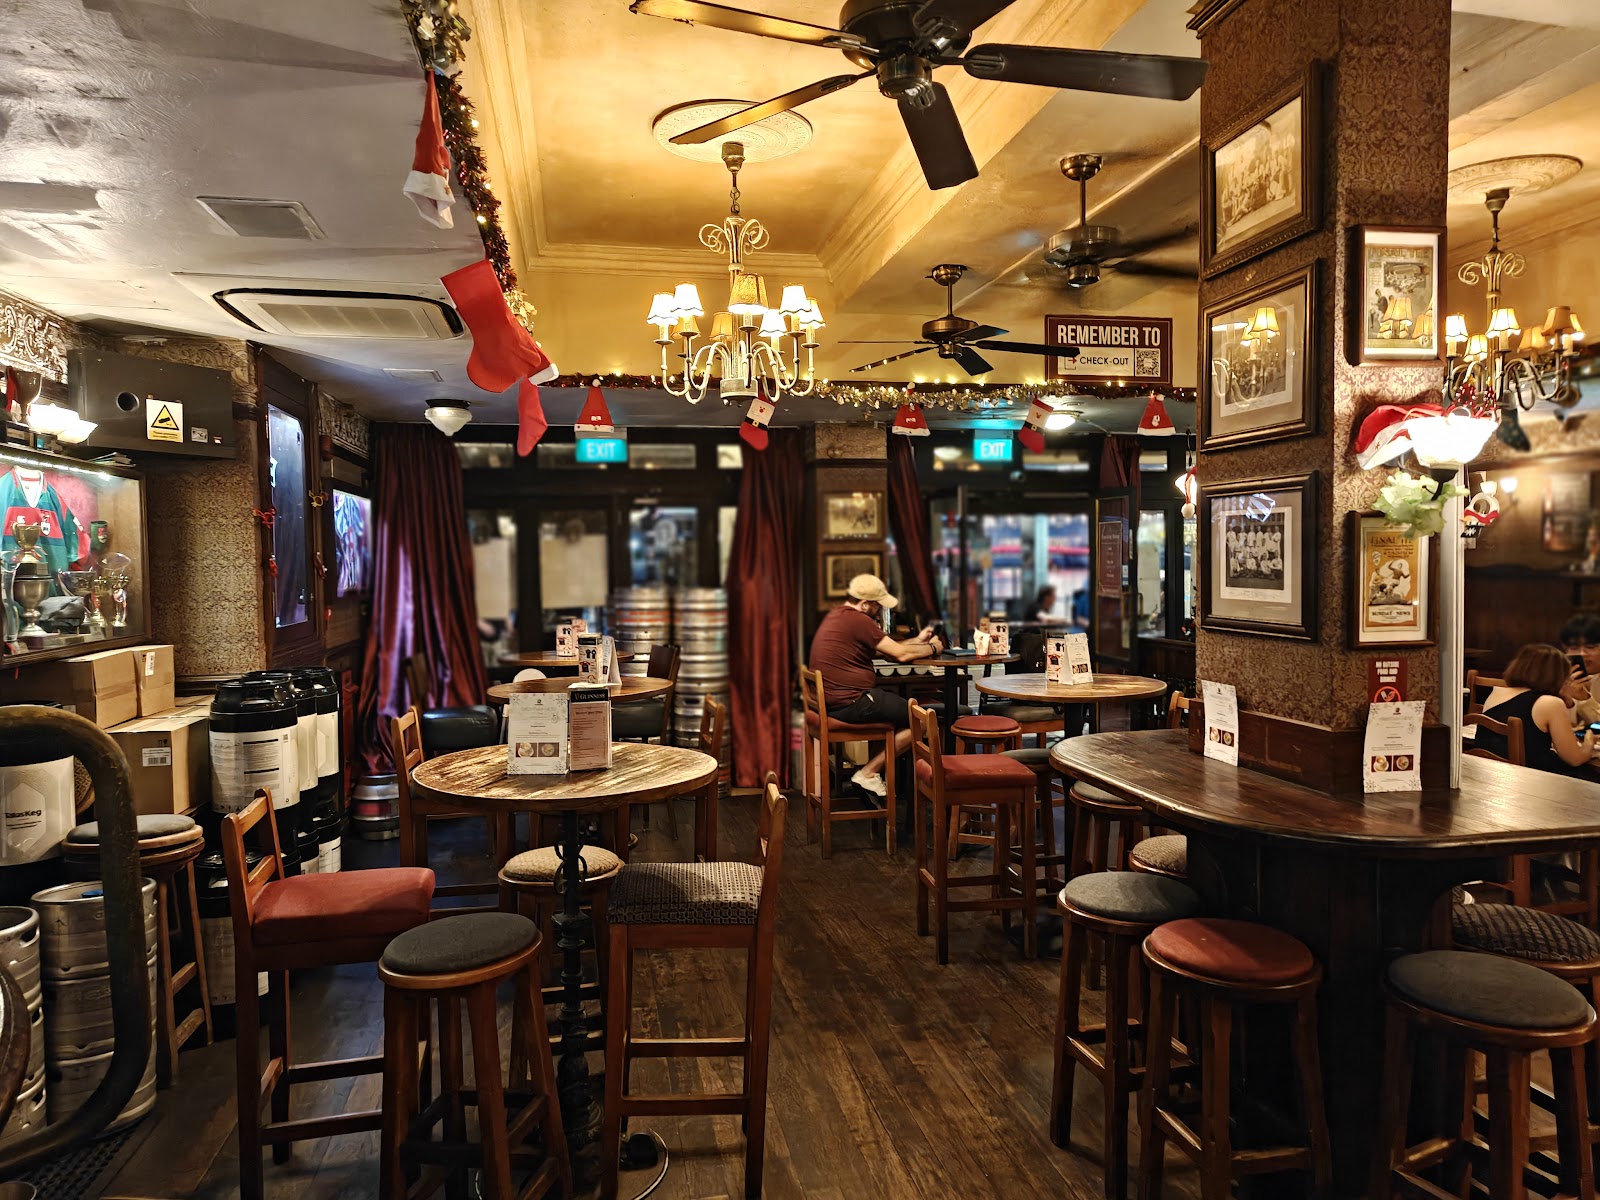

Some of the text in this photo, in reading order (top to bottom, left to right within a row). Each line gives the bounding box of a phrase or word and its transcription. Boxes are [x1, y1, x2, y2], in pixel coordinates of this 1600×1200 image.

[1057, 324, 1161, 346] REMEMBER TO
[1079, 356, 1129, 366] CHECK-OUT
[586, 442, 617, 459] EXIT
[980, 442, 1006, 458] EXIT
